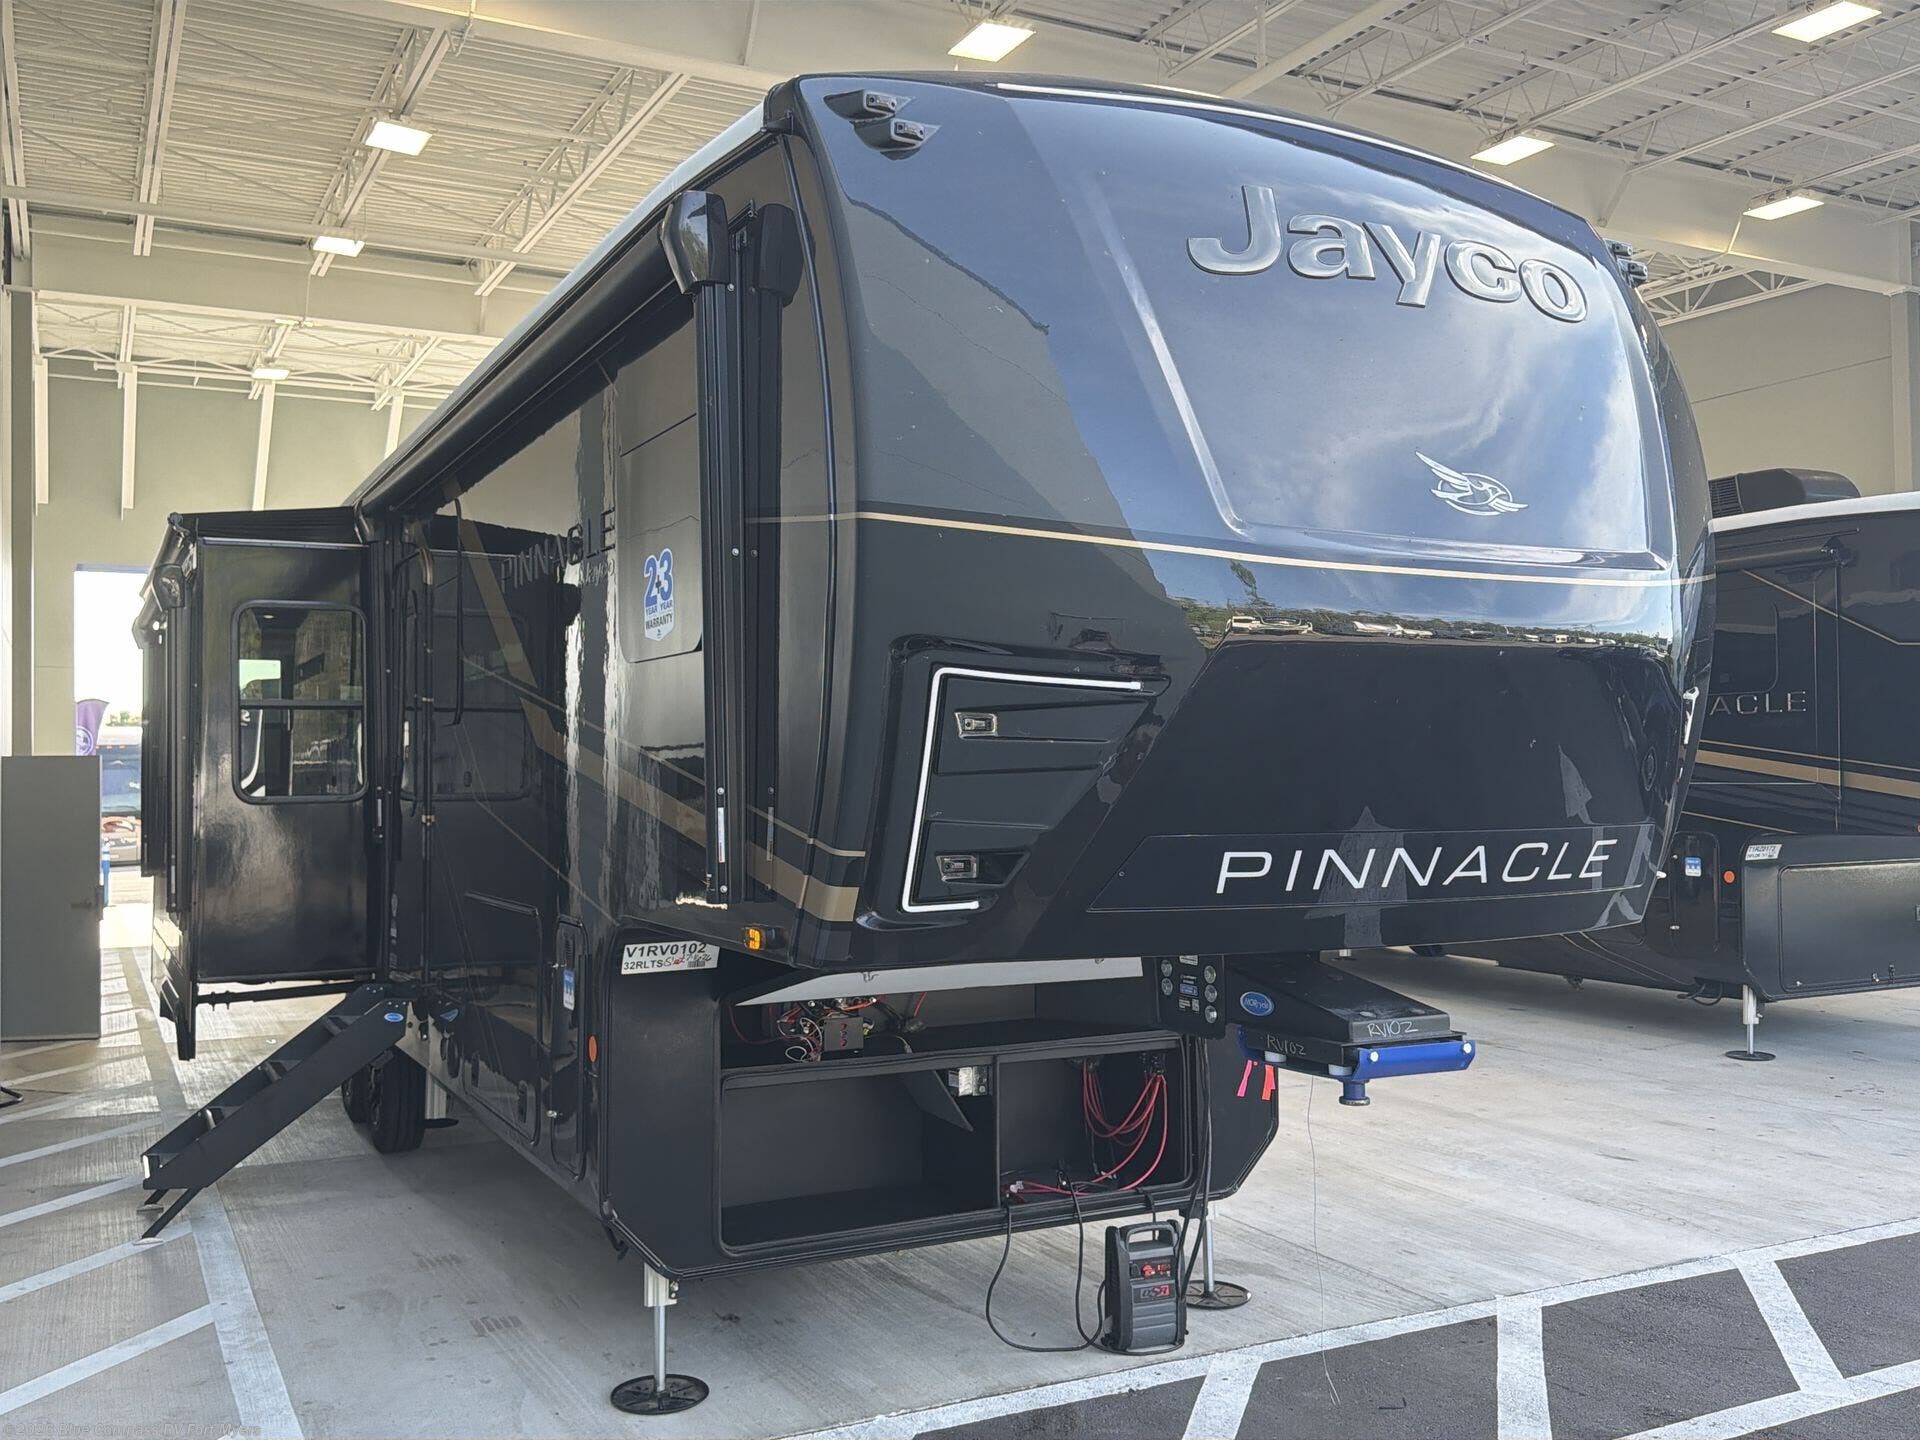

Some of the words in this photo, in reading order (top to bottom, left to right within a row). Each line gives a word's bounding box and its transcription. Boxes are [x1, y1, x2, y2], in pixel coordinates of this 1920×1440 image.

[1187, 184, 1589, 322] Jayco
[646, 605, 657, 615] YEAR
[660, 600, 673, 611] YEAR
[646, 613, 673, 630] WARRANTY
[1216, 838, 1619, 895] PINNACLE
[626, 943, 707, 958] V1RV0102
[623, 959, 663, 970] 32RLTS
